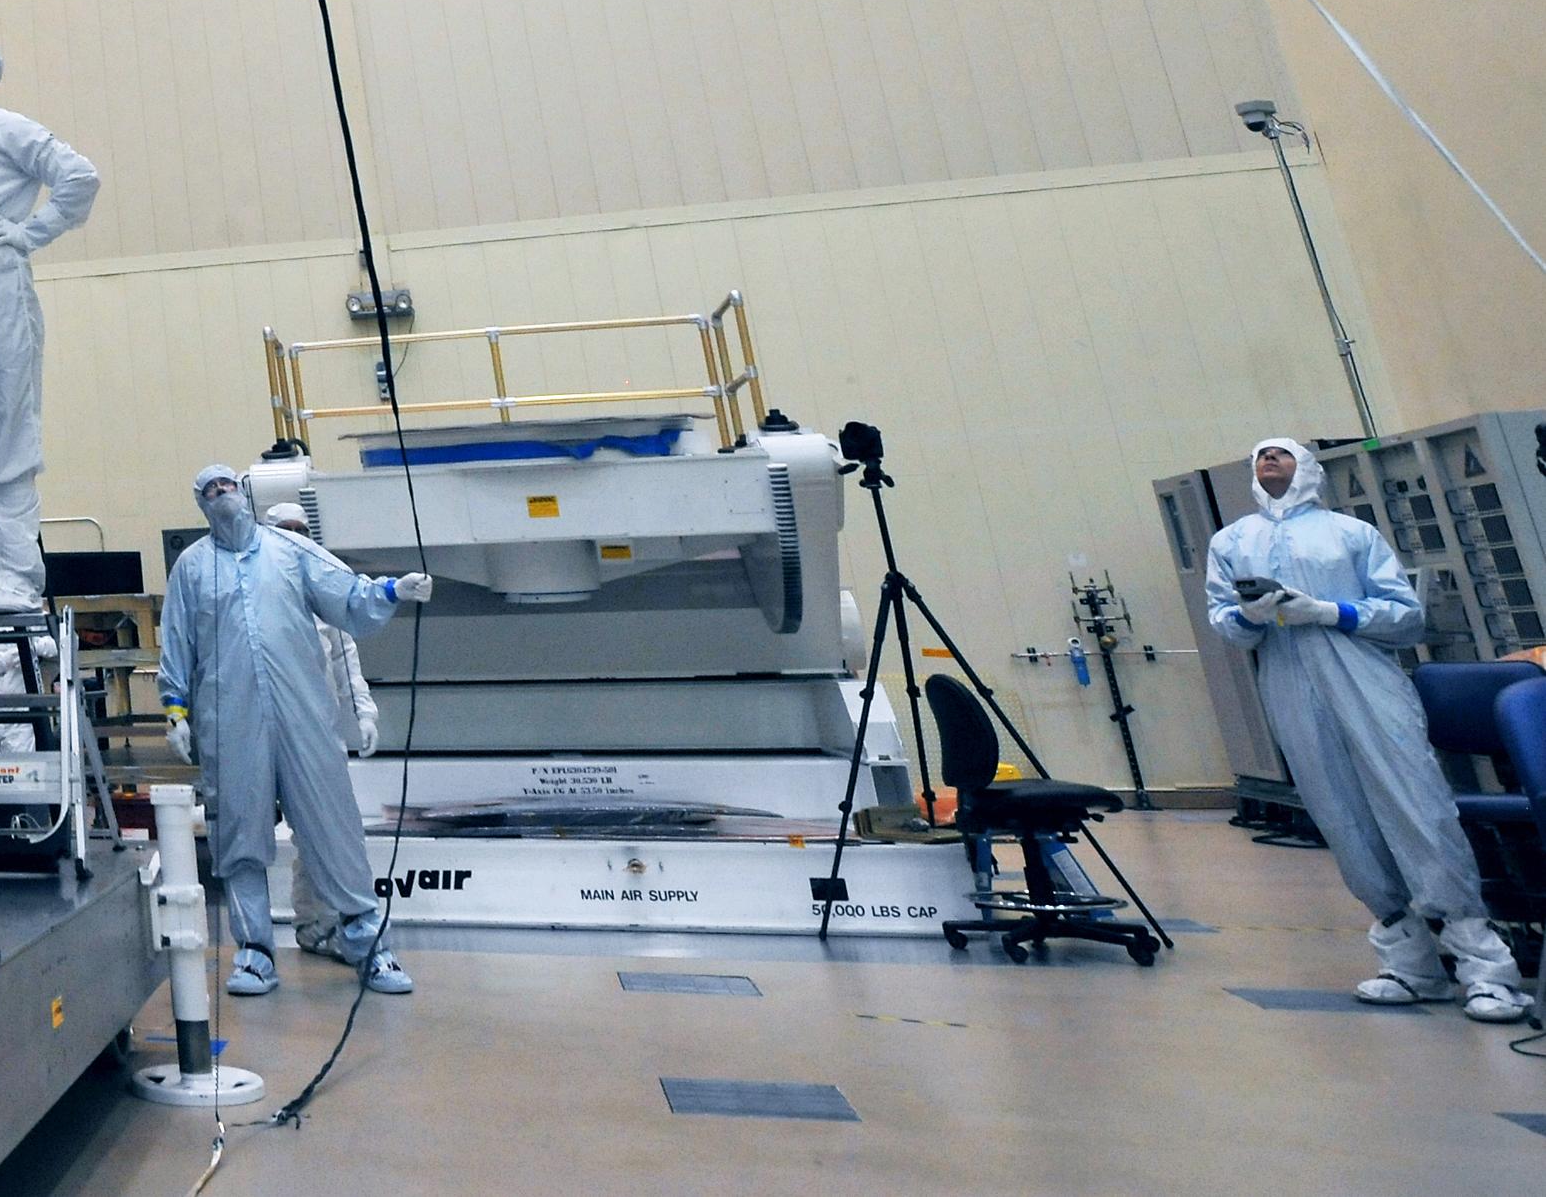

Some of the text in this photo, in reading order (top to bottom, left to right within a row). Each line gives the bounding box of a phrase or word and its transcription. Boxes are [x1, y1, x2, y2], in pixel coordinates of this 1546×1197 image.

[539, 777, 567, 786] Weight
[375, 869, 472, 898] ovair
[580, 889, 699, 902] MAIN AIR SUPPLY
[871, 905, 901, 918] LBS
[907, 906, 938, 919] CAP
